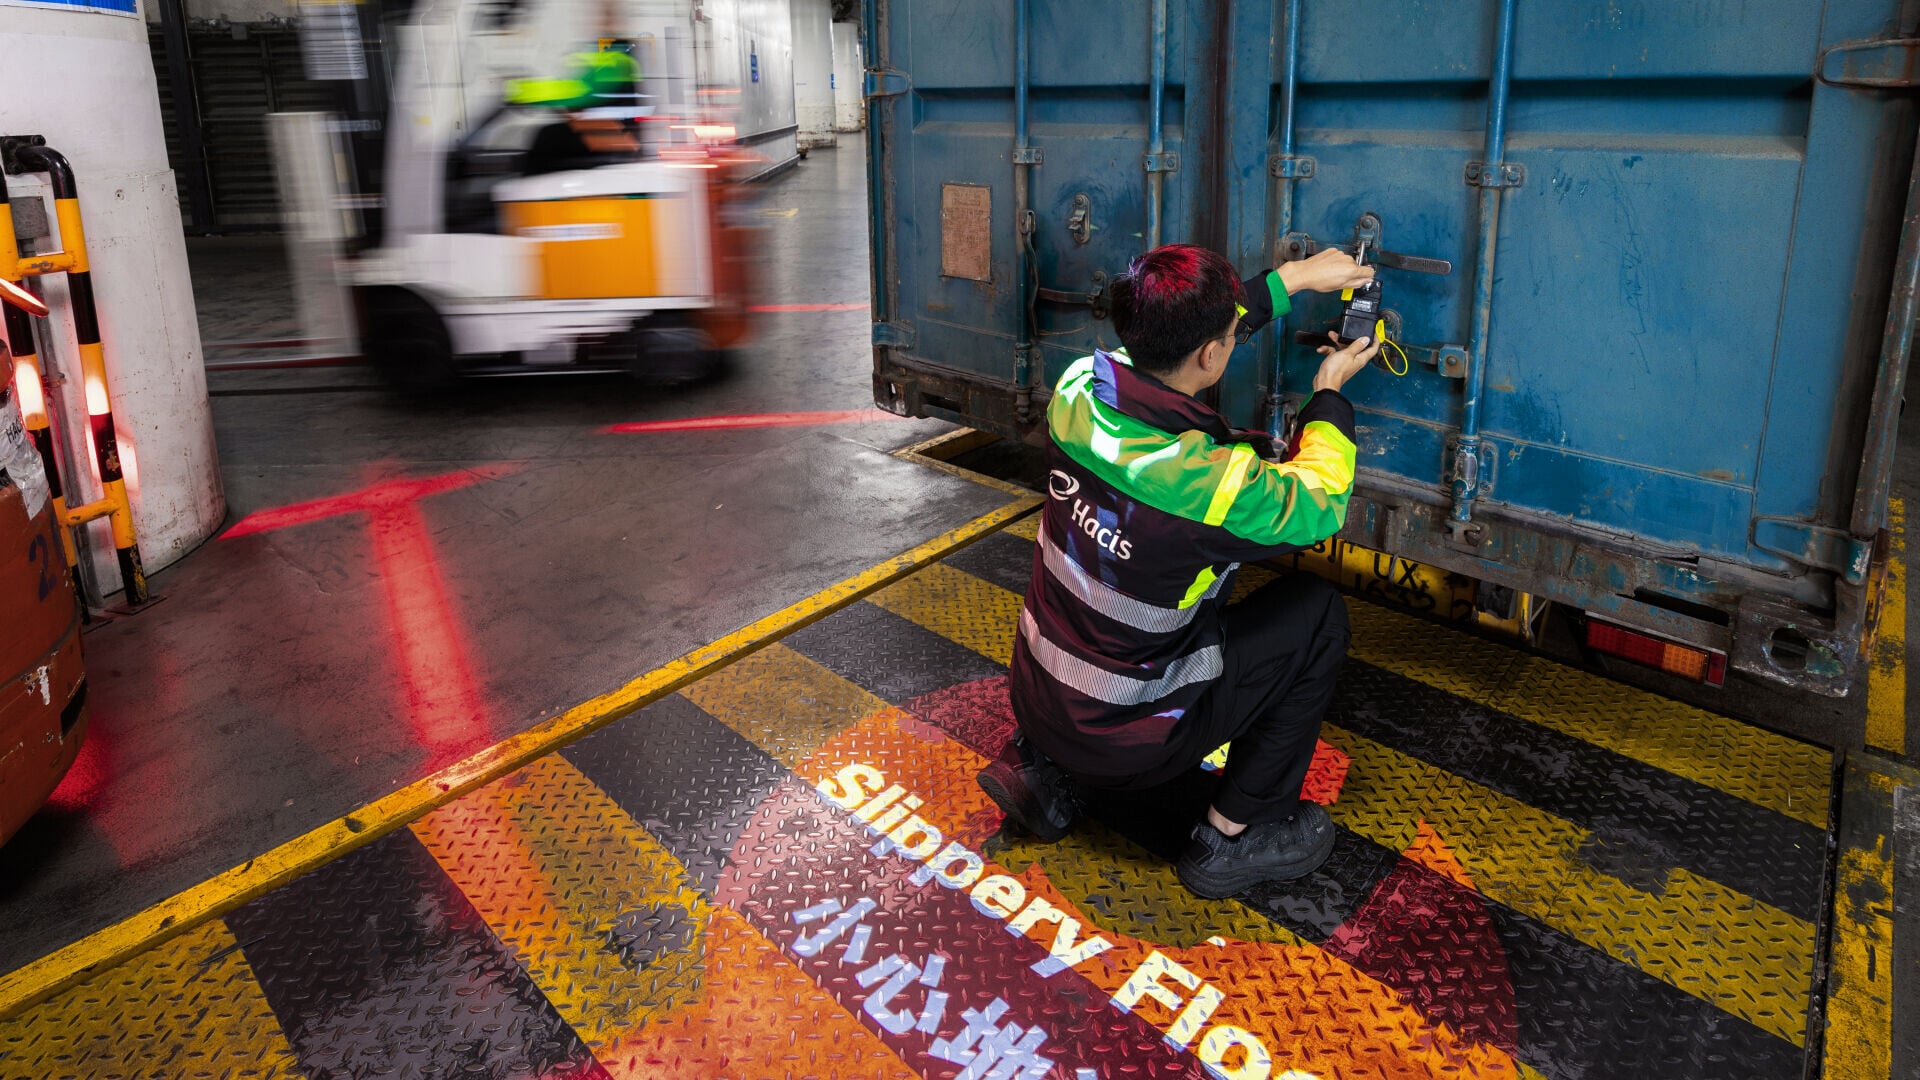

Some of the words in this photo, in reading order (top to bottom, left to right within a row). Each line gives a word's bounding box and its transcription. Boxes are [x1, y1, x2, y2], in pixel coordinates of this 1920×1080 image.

[1071, 498, 1133, 560] Hacis
[791, 897, 1098, 1080] 小心地
[816, 763, 1113, 977] Slippery
[1109, 949, 1323, 1080] Flo
